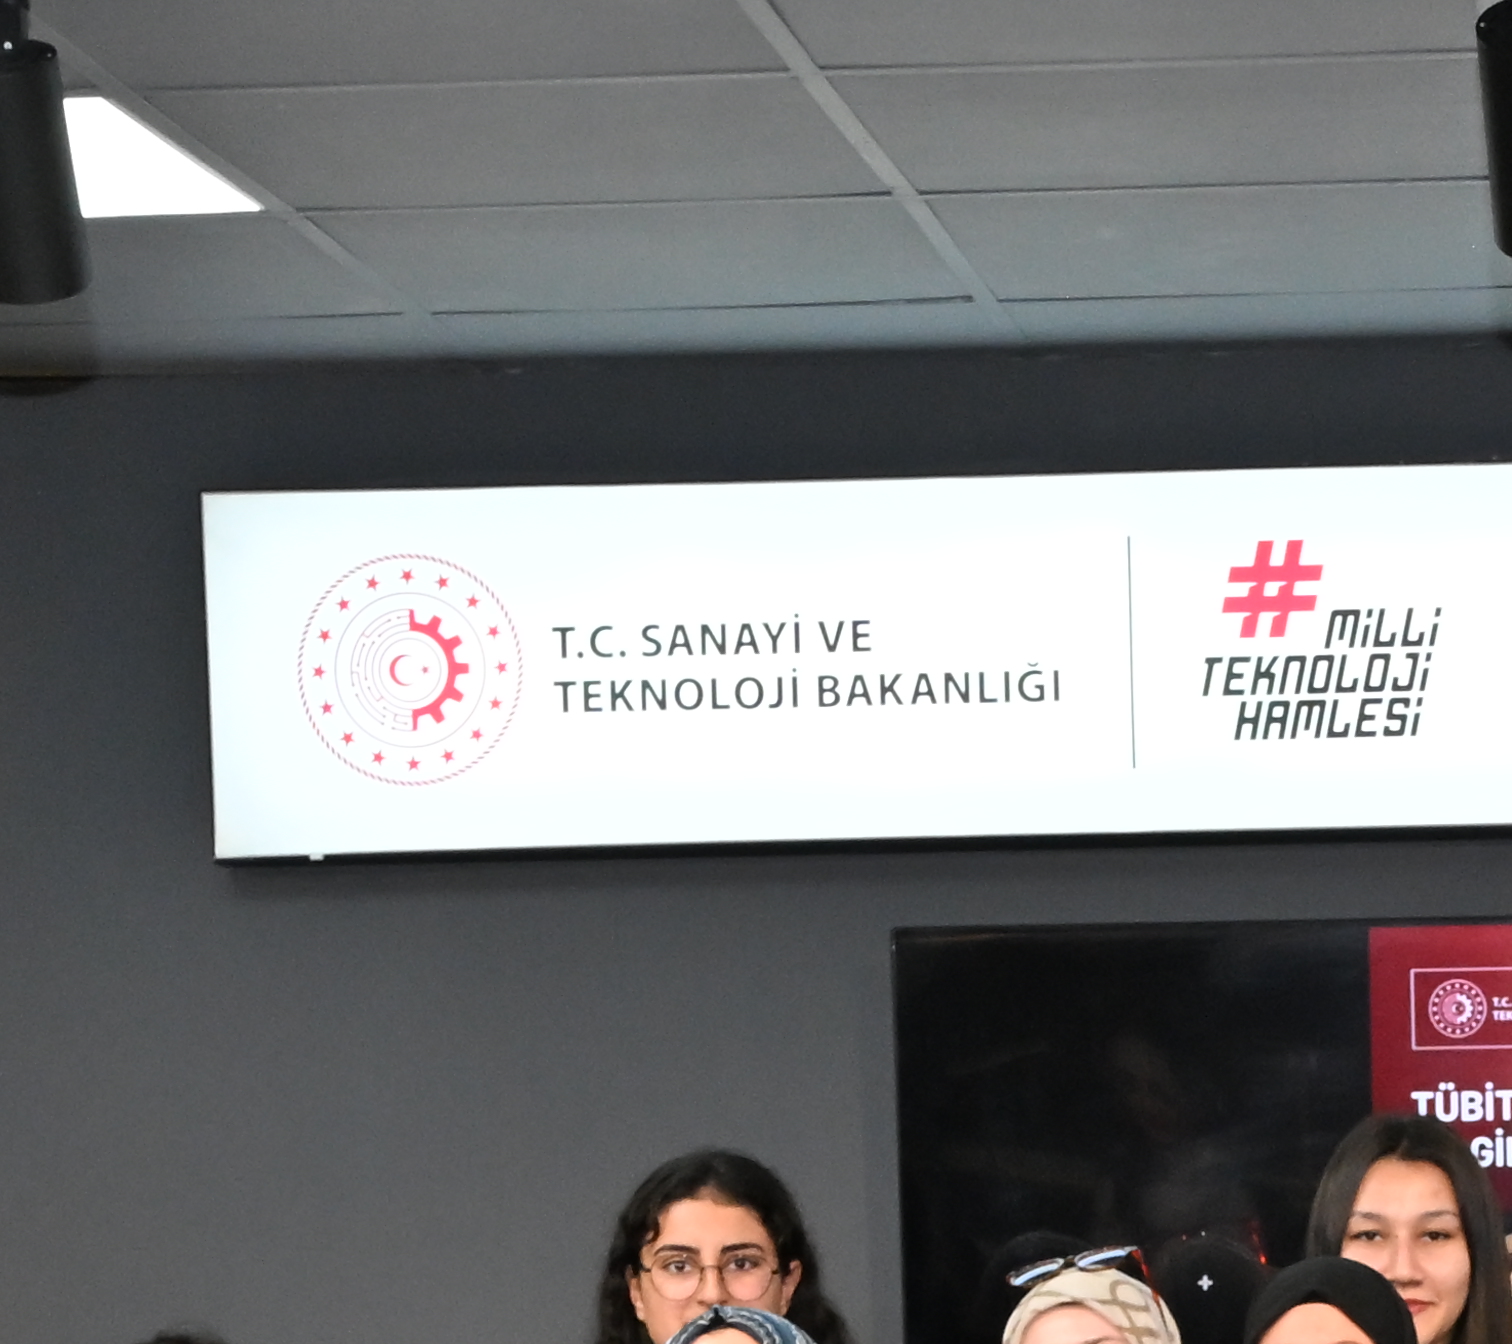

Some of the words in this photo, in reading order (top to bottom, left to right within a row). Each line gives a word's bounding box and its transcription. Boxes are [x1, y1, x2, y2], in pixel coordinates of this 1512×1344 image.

[552, 624, 627, 660] T.C.
[640, 612, 802, 658] SANAYİ
[817, 619, 874, 655] VE
[553, 667, 800, 714] TEKNOLOJİ
[817, 662, 1062, 708] BAKANLIĞI
